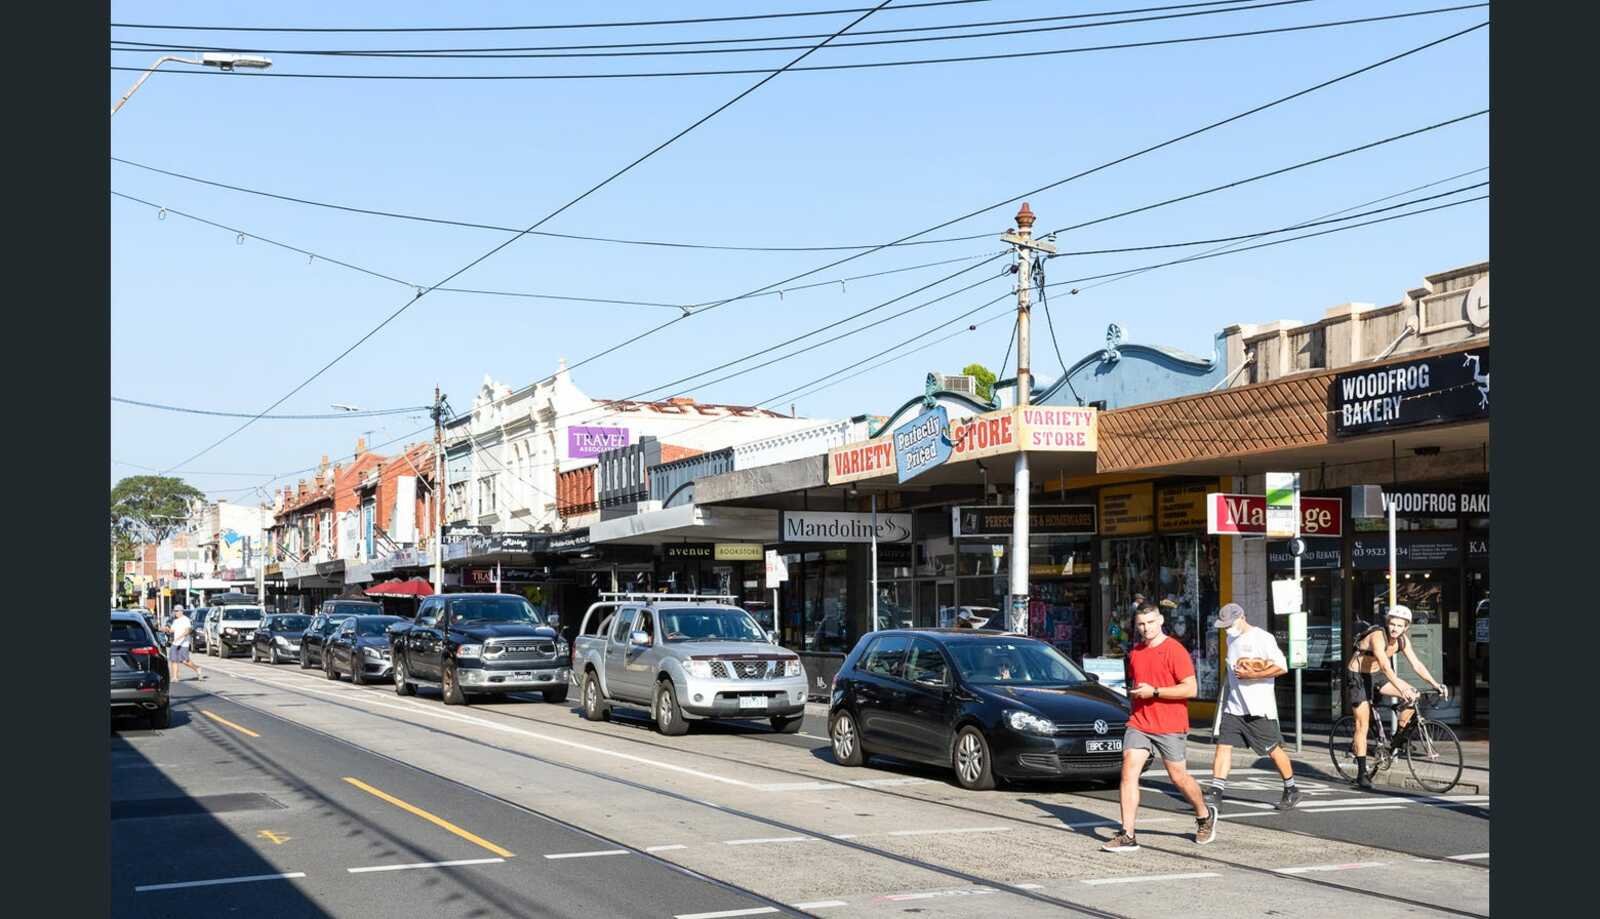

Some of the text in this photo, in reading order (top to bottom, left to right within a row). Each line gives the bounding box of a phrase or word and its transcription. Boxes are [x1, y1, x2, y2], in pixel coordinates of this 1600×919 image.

[1342, 363, 1430, 400] WOODFROG
[1024, 410, 1092, 427] VARIETY
[1343, 395, 1402, 427] BAKERY
[573, 432, 625, 447] TRAVEL
[898, 415, 940, 451] Perfectly
[954, 414, 1013, 454] STORE
[1032, 431, 1086, 447] STORE
[834, 442, 893, 476] VARIETY
[905, 442, 937, 472] Priced
[1225, 497, 1332, 533] Mage
[1380, 491, 1489, 513] WOODFROG BAK
[787, 516, 884, 539] Mandoline
[669, 546, 760, 556] avenue BOOKSTORE
